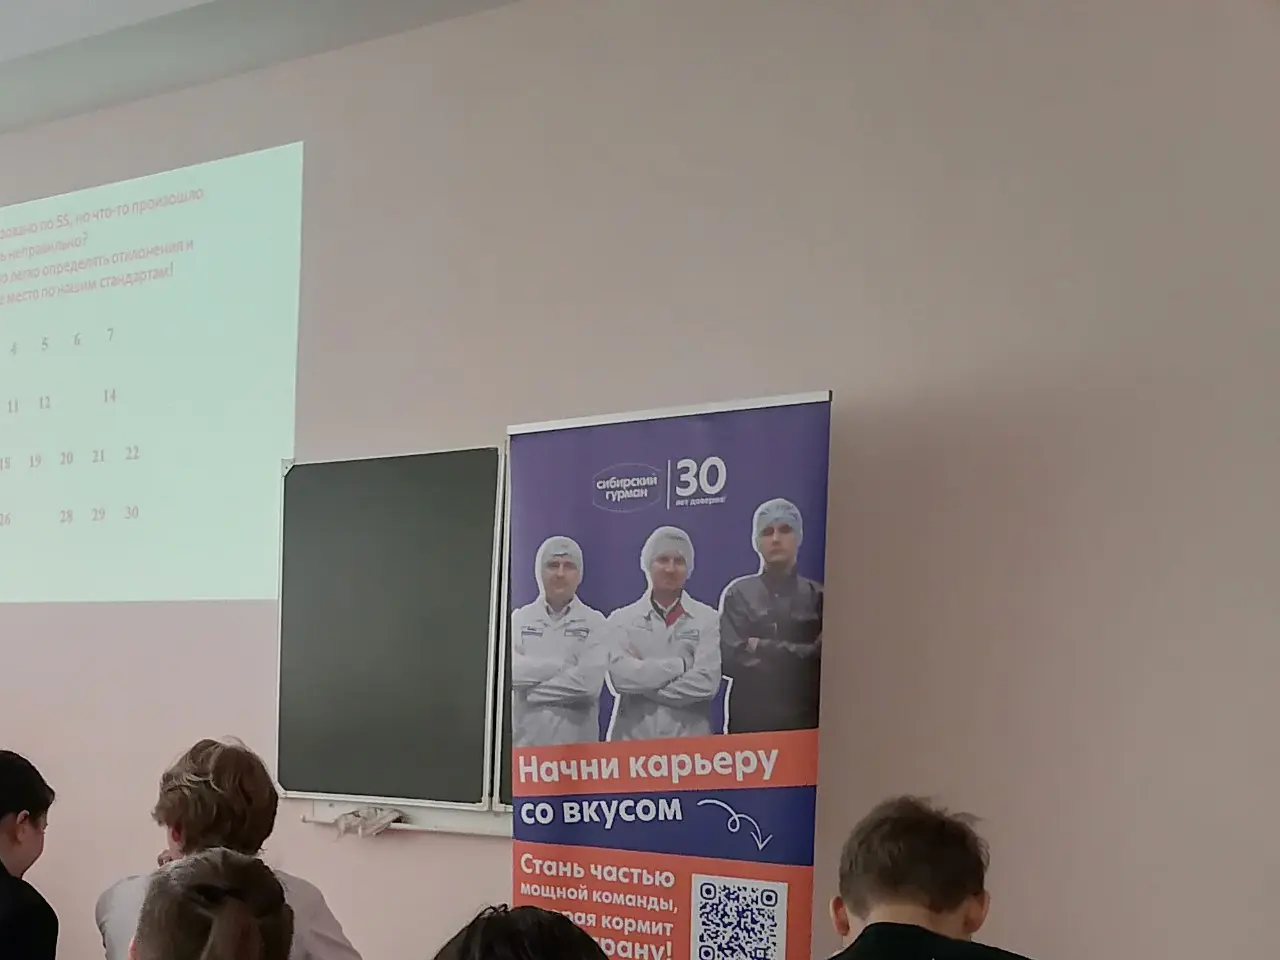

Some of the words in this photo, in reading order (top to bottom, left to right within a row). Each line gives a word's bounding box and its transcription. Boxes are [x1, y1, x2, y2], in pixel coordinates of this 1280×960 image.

[40, 220, 54, 232] по
[75, 212, 90, 224] но
[93, 204, 129, 221] что-то
[132, 188, 204, 215] произошло
[8, 231, 88, 262] неправильно?
[10, 267, 40, 283] легко
[42, 256, 110, 277] определять
[112, 241, 184, 265] отклонения
[185, 239, 194, 252] и
[7, 289, 40, 304] место
[41, 285, 55, 298] по
[57, 279, 97, 295] нашим
[99, 261, 175, 289] стандартам!
[8, 400, 19, 413] 11
[39, 396, 51, 409] 12
[104, 388, 116, 403] 14
[0, 457, 11, 471] 18
[29, 454, 42, 468] 19
[60, 451, 73, 465] 20
[92, 449, 105, 463] 21
[125, 446, 140, 460] 22
[596, 473, 658, 490] сибирский
[675, 456, 727, 497] 30
[605, 487, 648, 502] гурман
[60, 509, 73, 523] 28
[91, 507, 106, 521] 29
[124, 505, 139, 519] 30
[519, 755, 620, 783] Начни
[629, 749, 779, 784] карьеру
[520, 801, 554, 825] со
[562, 798, 683, 829] вкусом
[520, 853, 585, 879] Стань
[590, 863, 675, 888] частью
[520, 882, 589, 901] мощной
[592, 890, 678, 914] команды,
[601, 915, 674, 936] кормит
